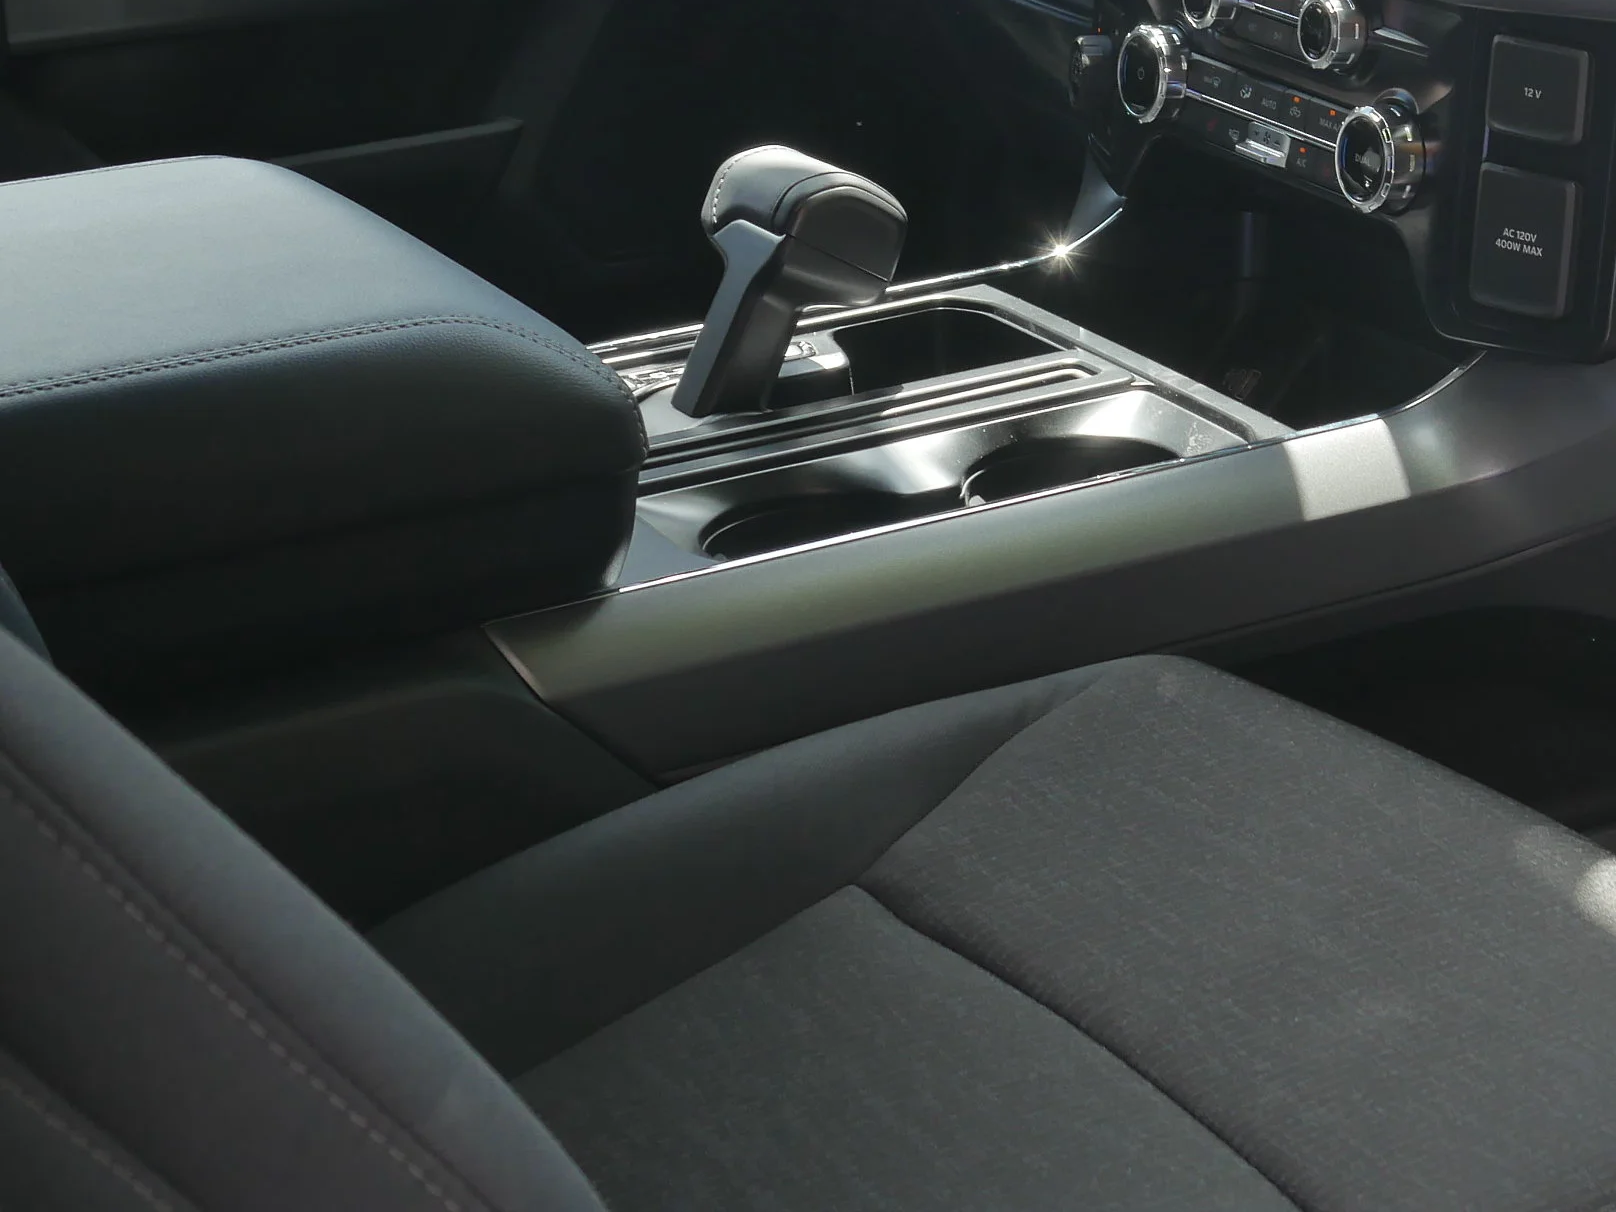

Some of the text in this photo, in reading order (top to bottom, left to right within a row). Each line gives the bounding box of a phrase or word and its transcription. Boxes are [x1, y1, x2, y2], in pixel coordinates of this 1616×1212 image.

[1523, 86, 1534, 98] 12
[1261, 97, 1277, 110] AUTO
[1502, 227, 1538, 244] AC 120V
[1495, 237, 1543, 257] 400W MAX
